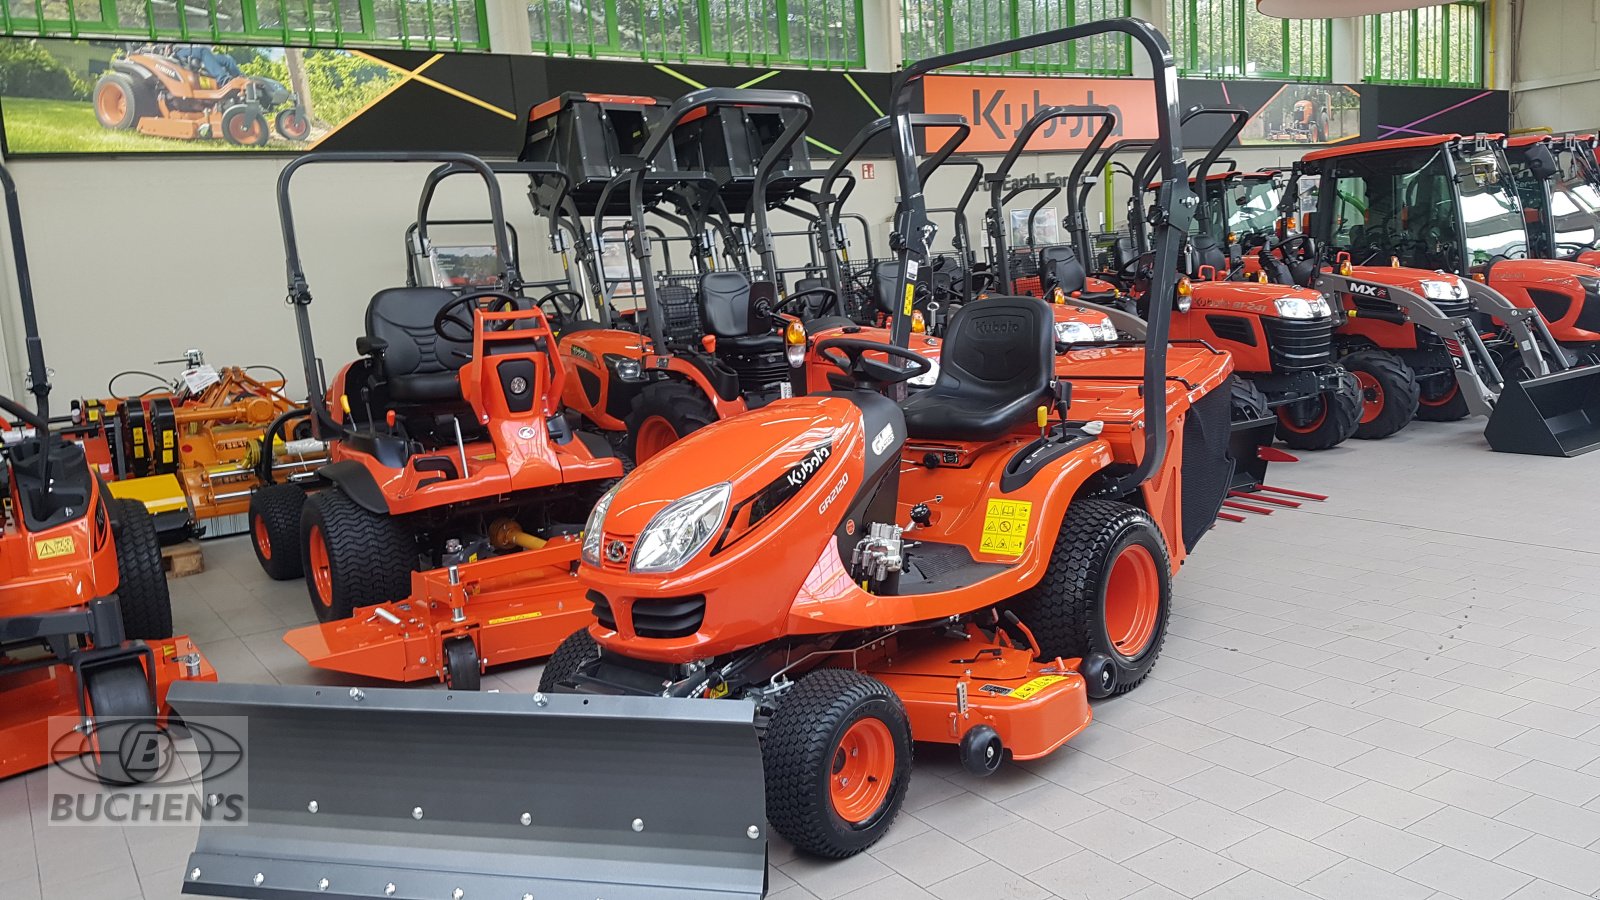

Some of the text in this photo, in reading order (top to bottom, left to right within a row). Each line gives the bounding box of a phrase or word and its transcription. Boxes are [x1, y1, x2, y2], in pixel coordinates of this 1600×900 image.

[1350, 282, 1377, 296] MX
[786, 447, 830, 486] Kubota
[818, 472, 849, 515] GR2120
